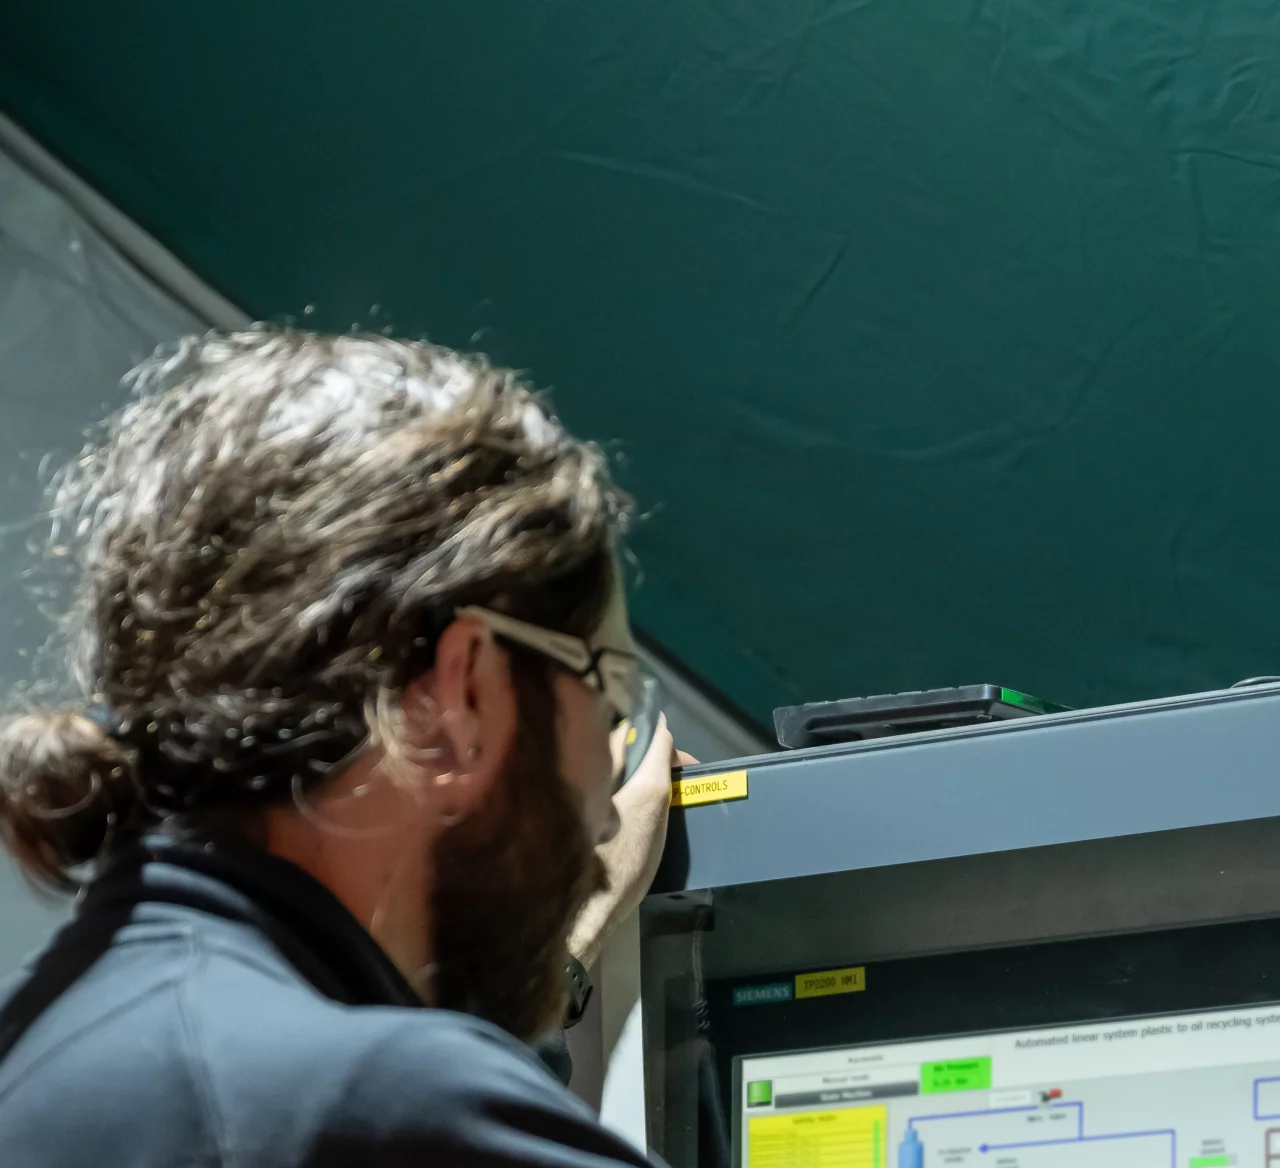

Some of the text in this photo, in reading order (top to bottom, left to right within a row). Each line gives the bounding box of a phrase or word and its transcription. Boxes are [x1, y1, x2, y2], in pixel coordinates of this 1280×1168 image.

[840, 973, 859, 987] HMI
[735, 985, 790, 1003] SIEMENS
[1014, 1032, 1069, 1050] Automated
[1072, 1030, 1099, 1044] linear
[1103, 1028, 1138, 1042] system
[1141, 1024, 1173, 1039] plastic
[1177, 1023, 1188, 1034] to
[1191, 1019, 1203, 1031] oil
[1206, 1015, 1253, 1031] recycling
